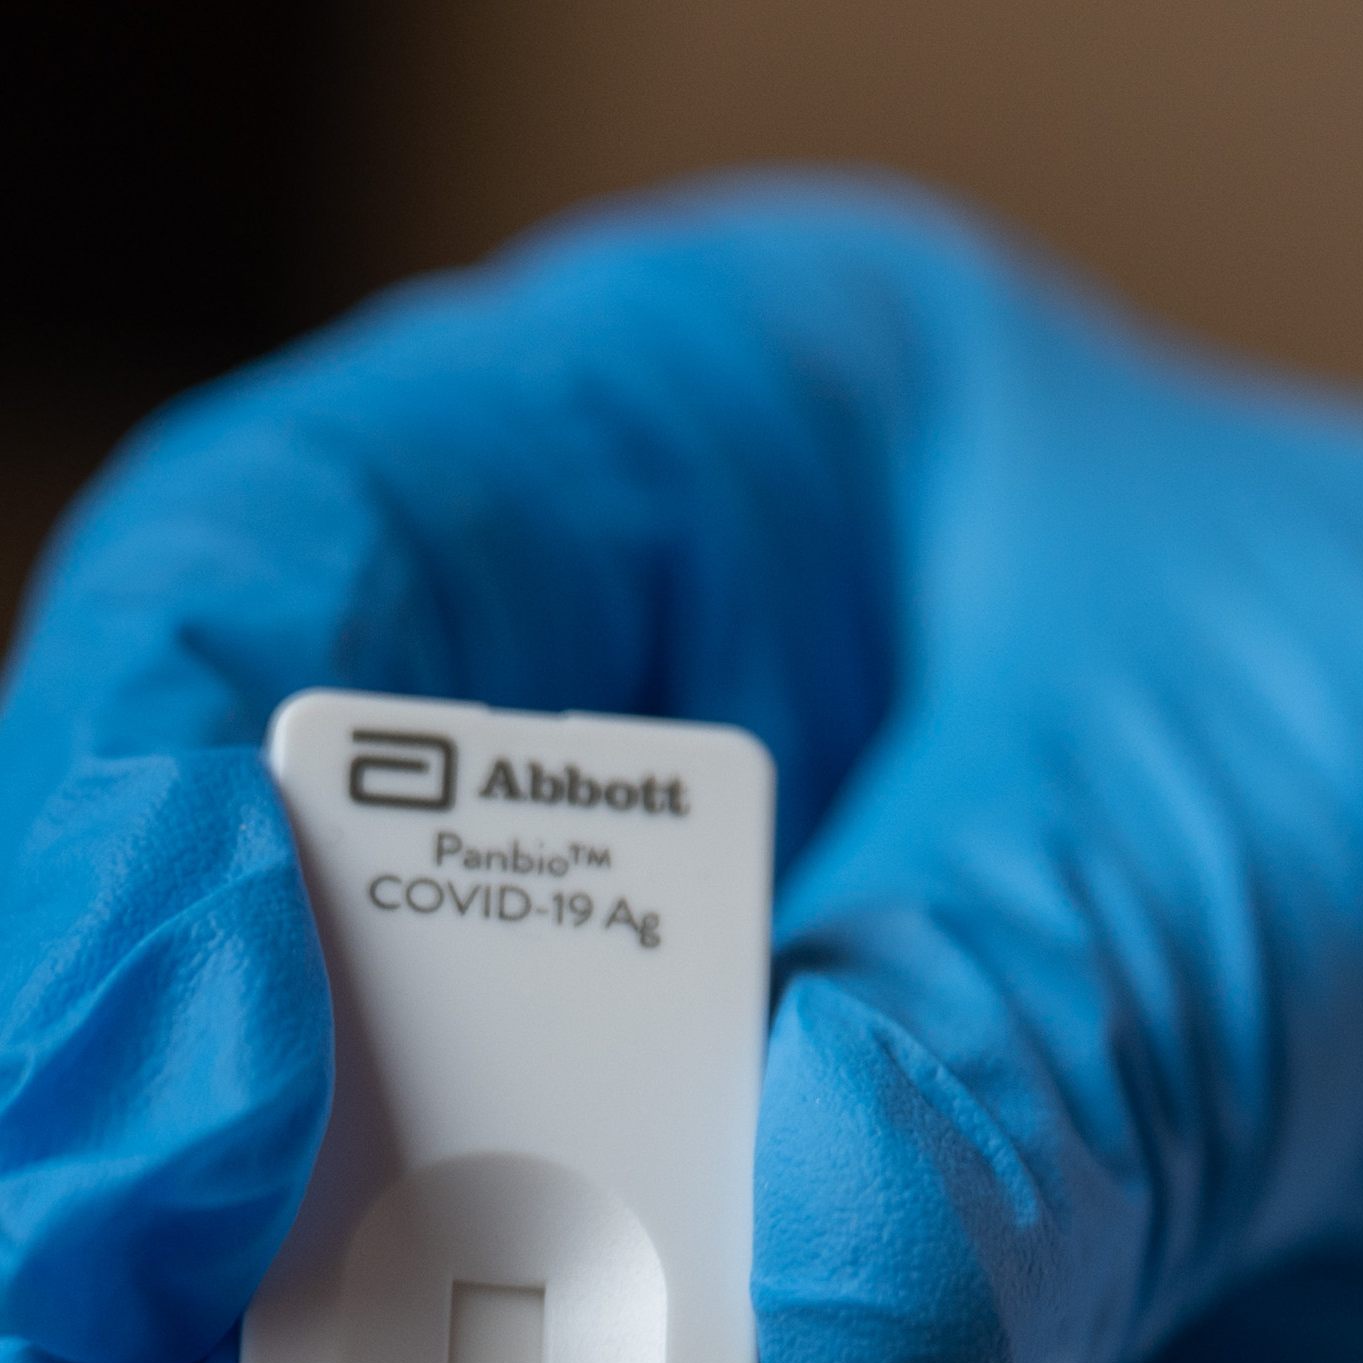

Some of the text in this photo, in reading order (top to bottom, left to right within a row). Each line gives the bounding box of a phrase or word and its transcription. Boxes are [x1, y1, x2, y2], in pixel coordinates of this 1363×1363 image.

[478, 758, 688, 816] Abbott
[369, 874, 661, 948] COVID-19 Ag
